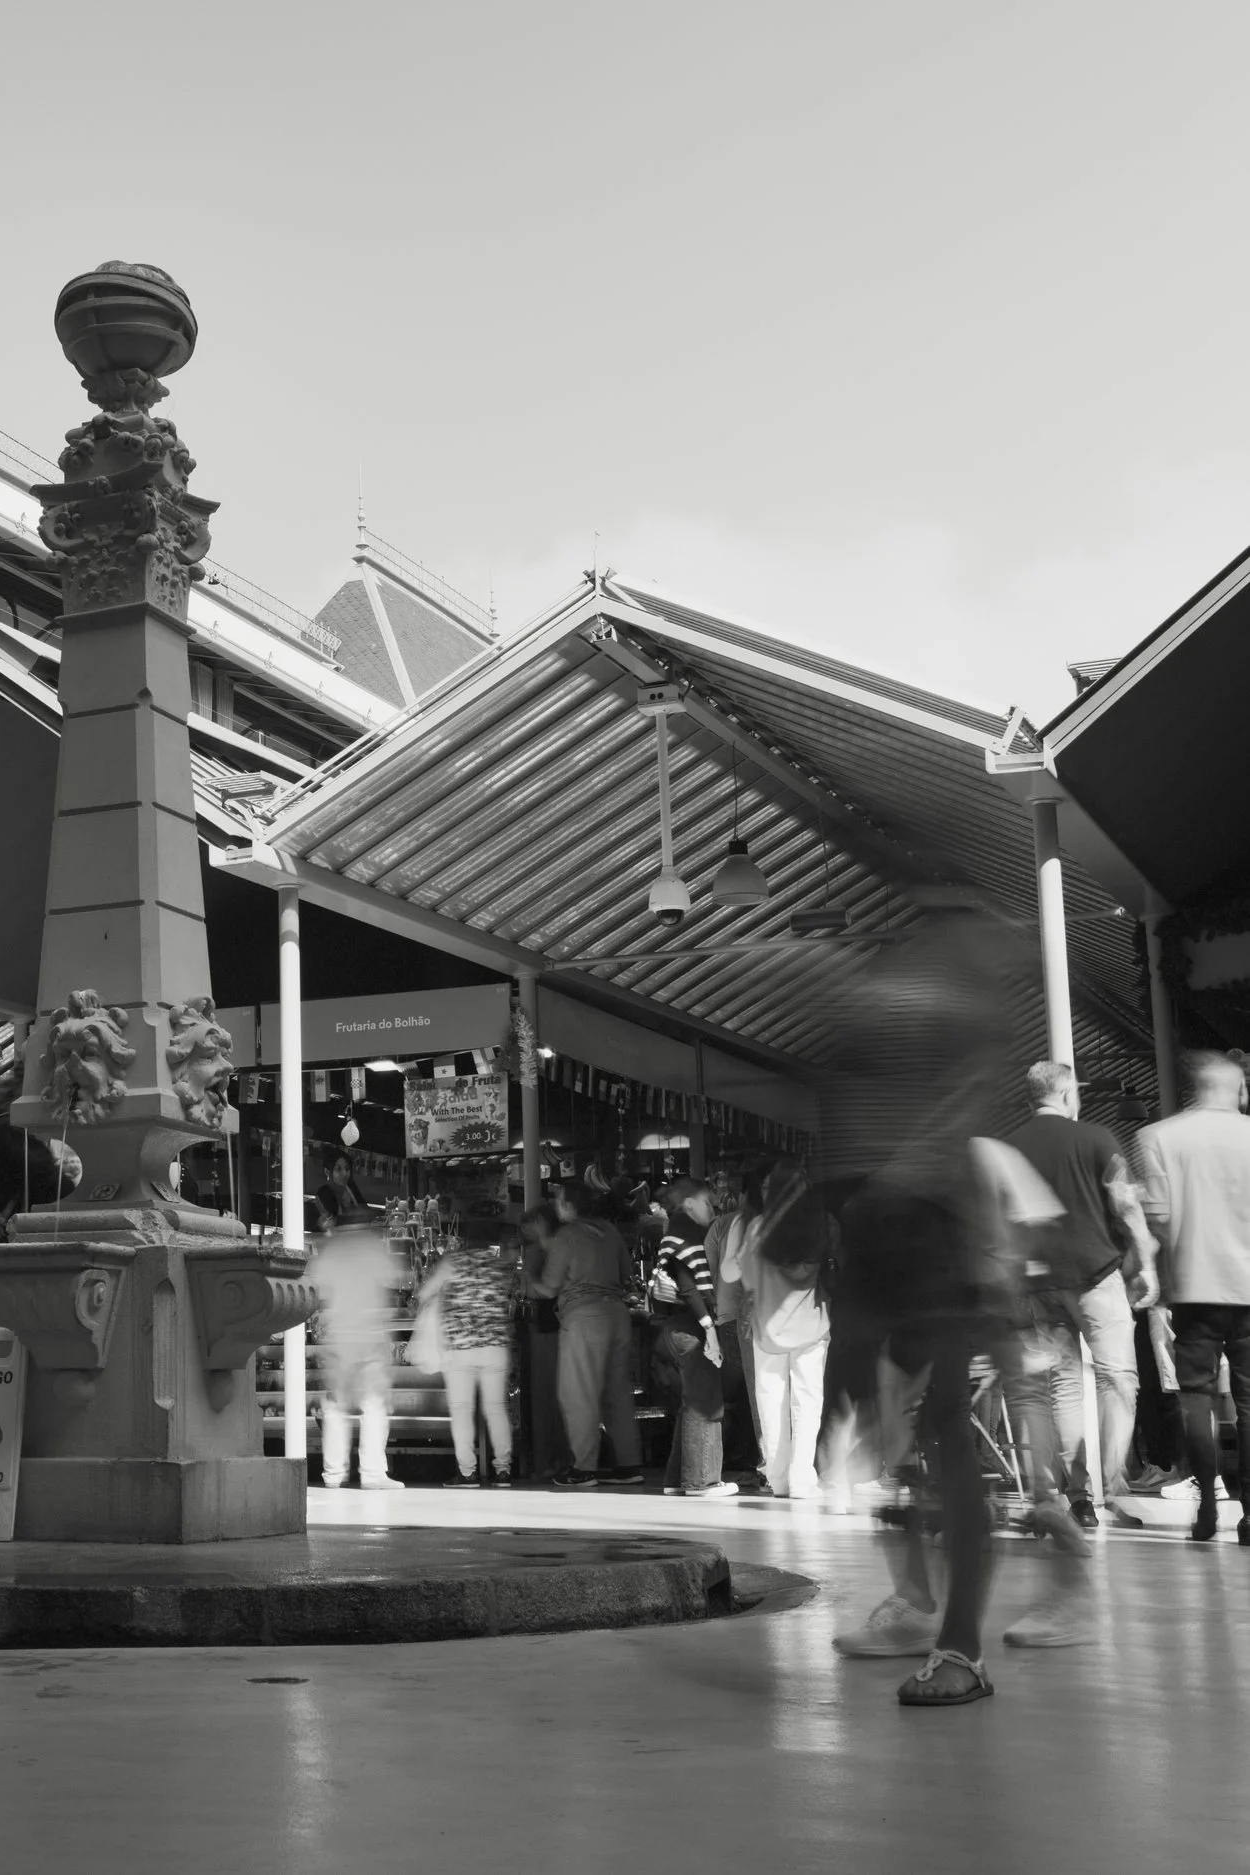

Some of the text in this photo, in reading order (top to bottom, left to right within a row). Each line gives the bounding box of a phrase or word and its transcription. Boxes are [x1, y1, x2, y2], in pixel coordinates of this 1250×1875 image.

[335, 1015, 431, 1033] Frutaria do Bolhão
[471, 1075, 501, 1086] Fruta
[430, 1105, 483, 1116] With The Best
